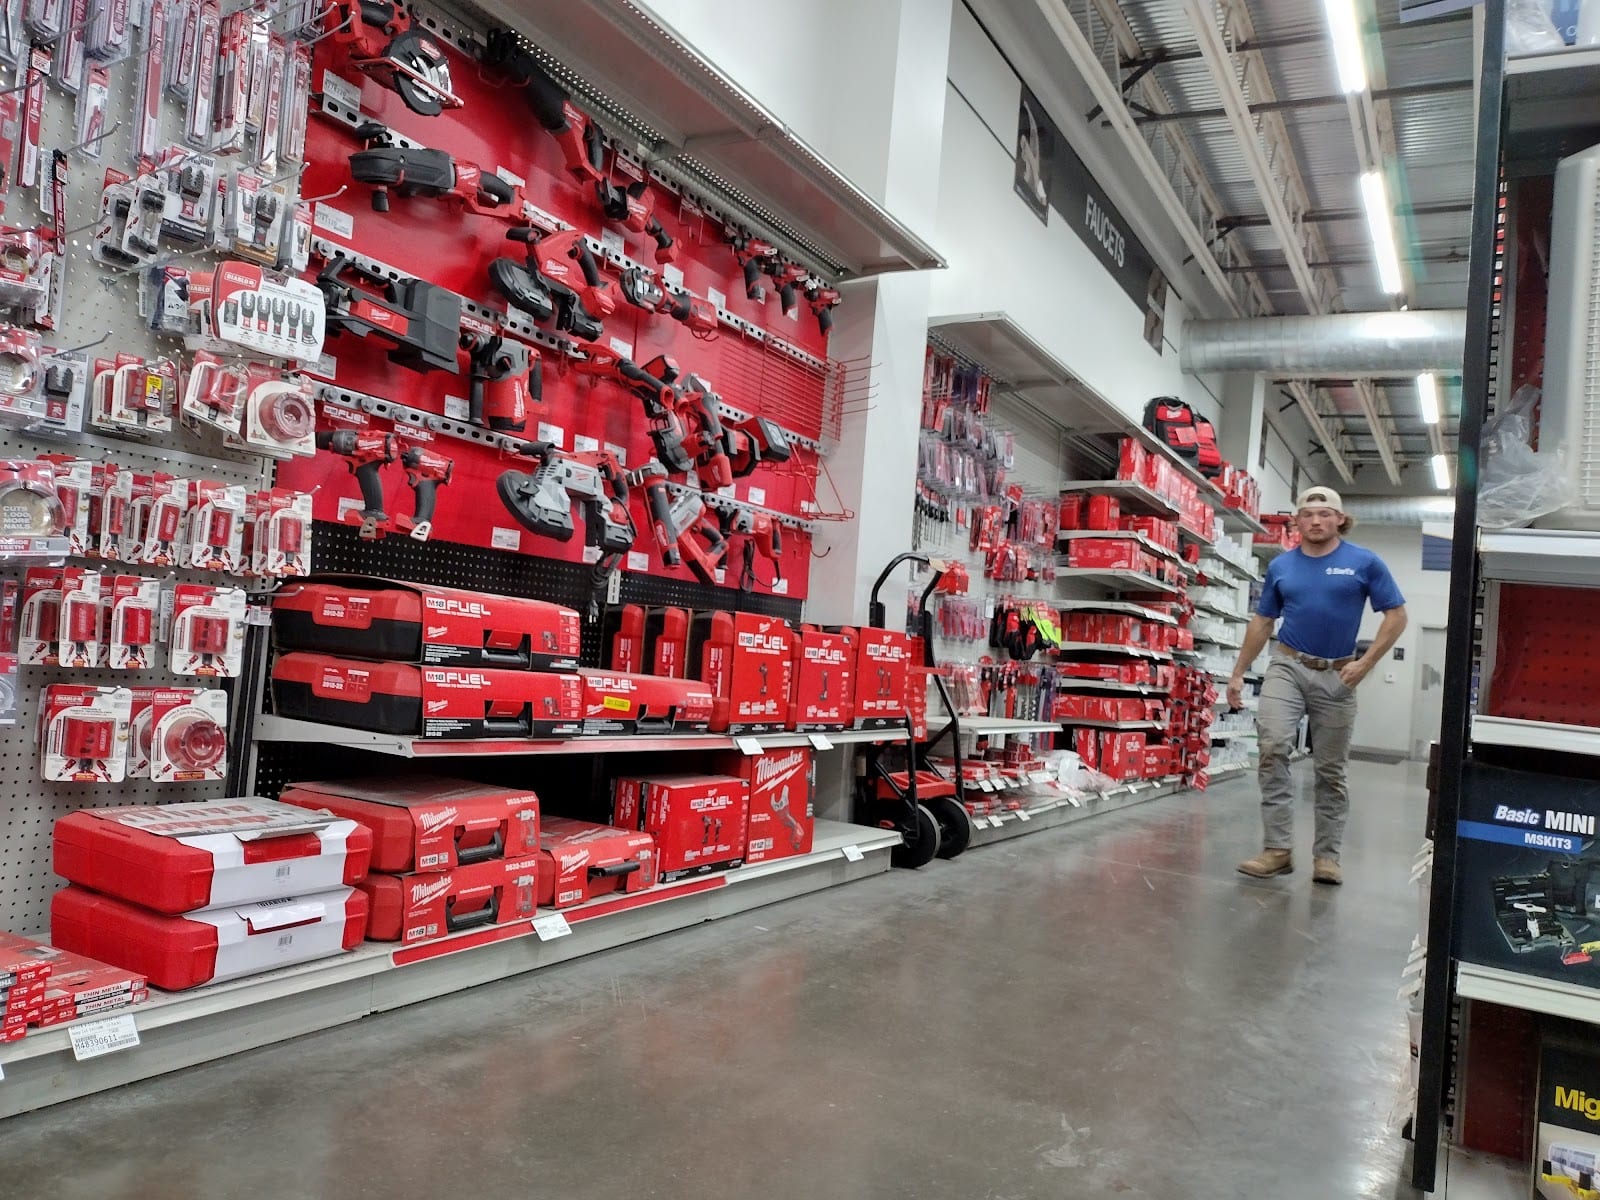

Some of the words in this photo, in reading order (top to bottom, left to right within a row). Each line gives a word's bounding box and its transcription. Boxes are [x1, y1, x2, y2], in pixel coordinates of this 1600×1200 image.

[1085, 194, 1125, 268] FAUCETS
[226, 273, 250, 285] DIABLO
[338, 410, 369, 424] FUEL
[407, 425, 435, 440] FUEL
[427, 598, 445, 608] M18
[446, 600, 492, 616] FUEL
[754, 634, 789, 651] FUEL
[818, 649, 847, 661] FUEL
[879, 645, 905, 659] FUEL
[426, 672, 445, 682] M18
[446, 673, 492, 686] FUEL
[603, 678, 638, 690] FUEL
[754, 750, 804, 785] Milwaukee
[704, 796, 733, 807] FUEL
[420, 806, 457, 830] Milwaukee
[1495, 804, 1540, 825] Basic
[1544, 809, 1595, 835] MINI
[750, 841, 764, 850] M12
[1524, 833, 1572, 850] MSKIT3
[421, 856, 438, 866] M18
[411, 876, 453, 903] Milwaukee
[408, 926, 424, 938] M18
[83, 990, 100, 998] THIN
[101, 984, 124, 993] METAL
[85, 1002, 102, 1011] THIN
[103, 997, 125, 1006] METAL
